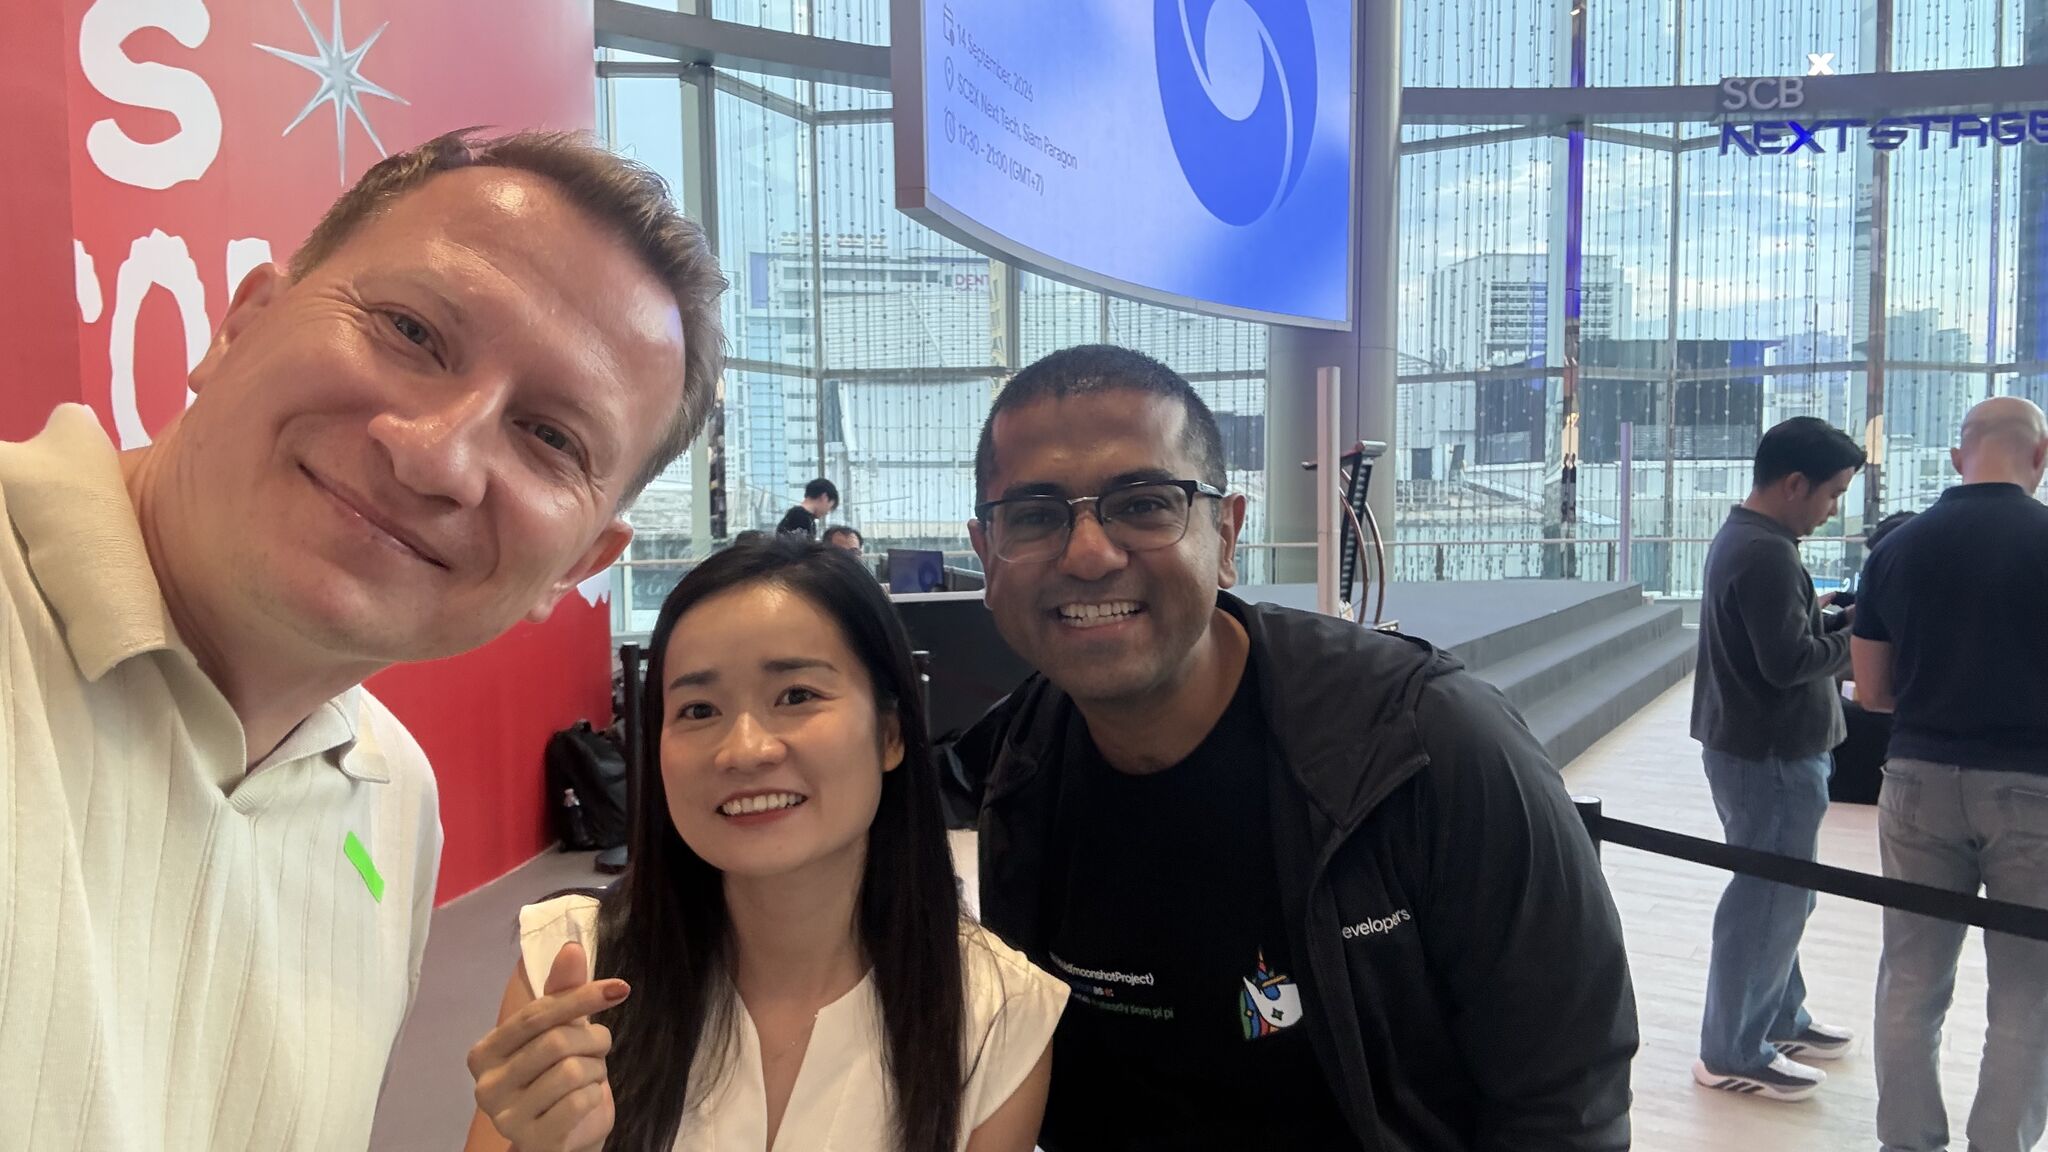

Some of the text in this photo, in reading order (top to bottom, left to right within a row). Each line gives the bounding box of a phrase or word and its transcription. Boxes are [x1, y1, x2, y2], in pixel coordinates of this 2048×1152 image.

[957, 23, 967, 48] 14
[1722, 76, 1804, 110] SCB
[1718, 109, 2048, 157] NEXT STAGE
[1043, 134, 1078, 170] Paragon
[1341, 908, 1411, 940] evelopers
